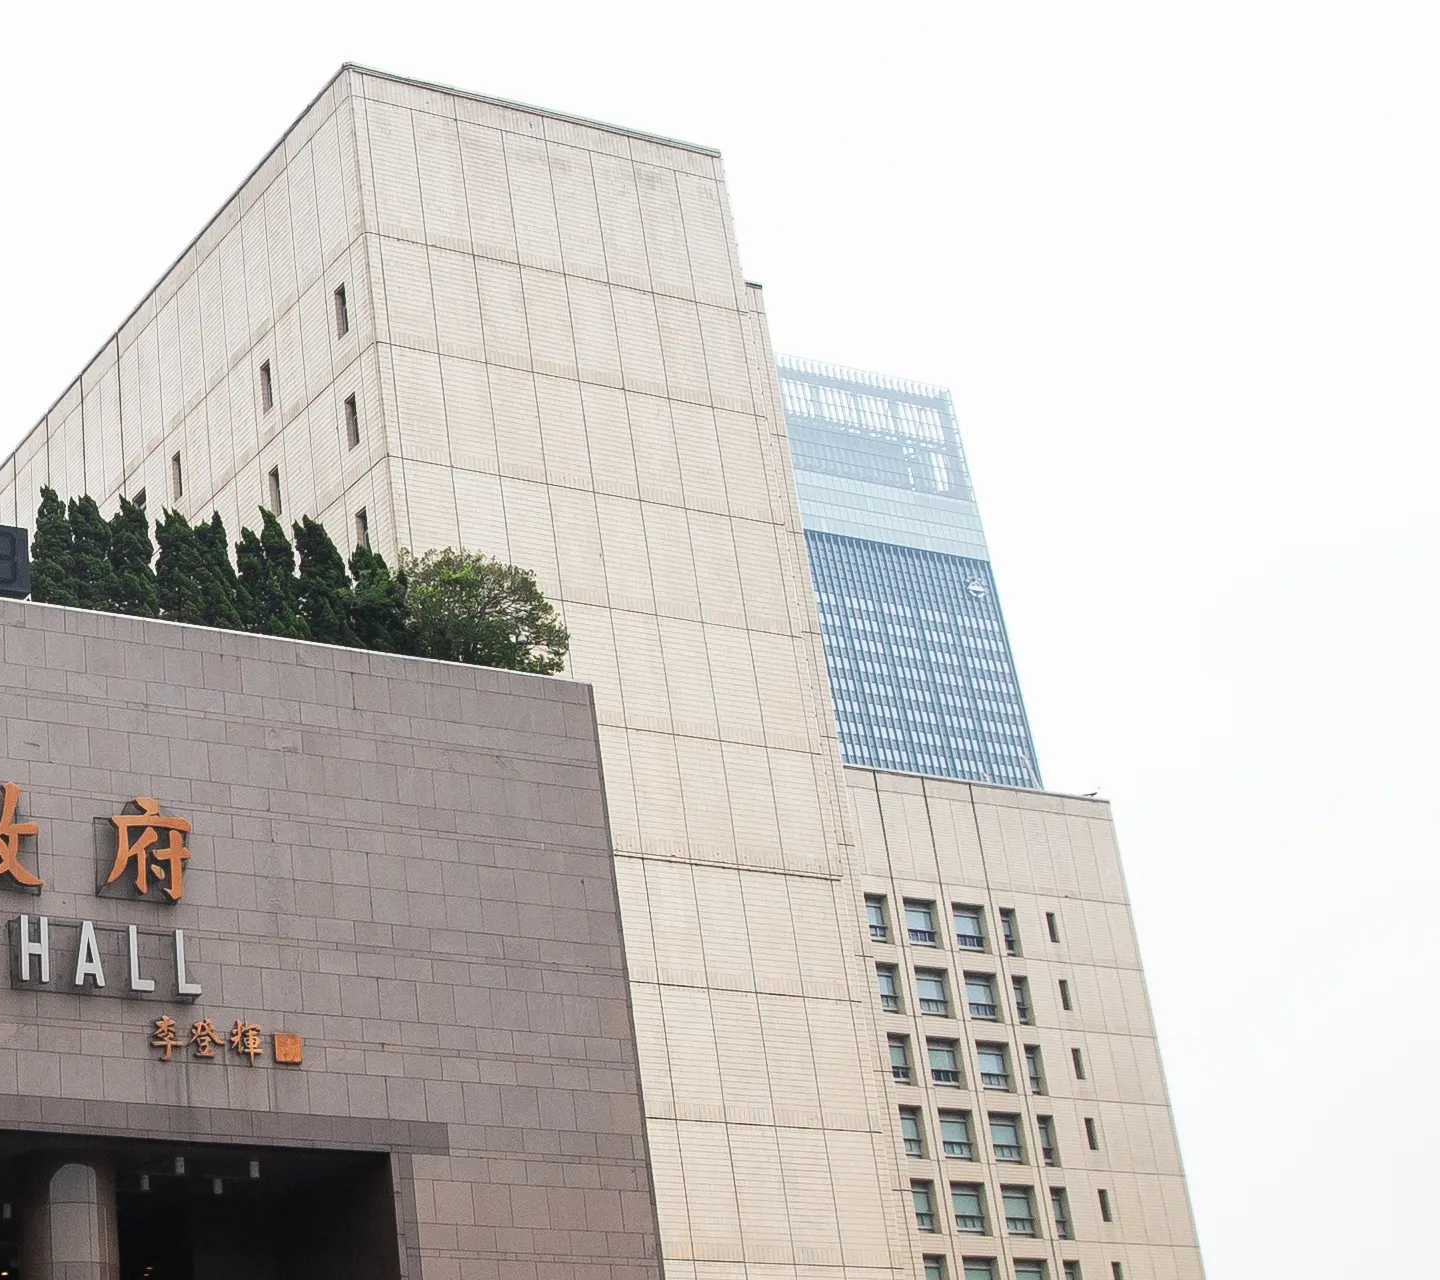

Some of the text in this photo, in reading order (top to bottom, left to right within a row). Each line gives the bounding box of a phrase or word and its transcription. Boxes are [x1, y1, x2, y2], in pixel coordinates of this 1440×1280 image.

[20, 914, 203, 997] HALL
[150, 1014, 264, 1067] 李登輝
